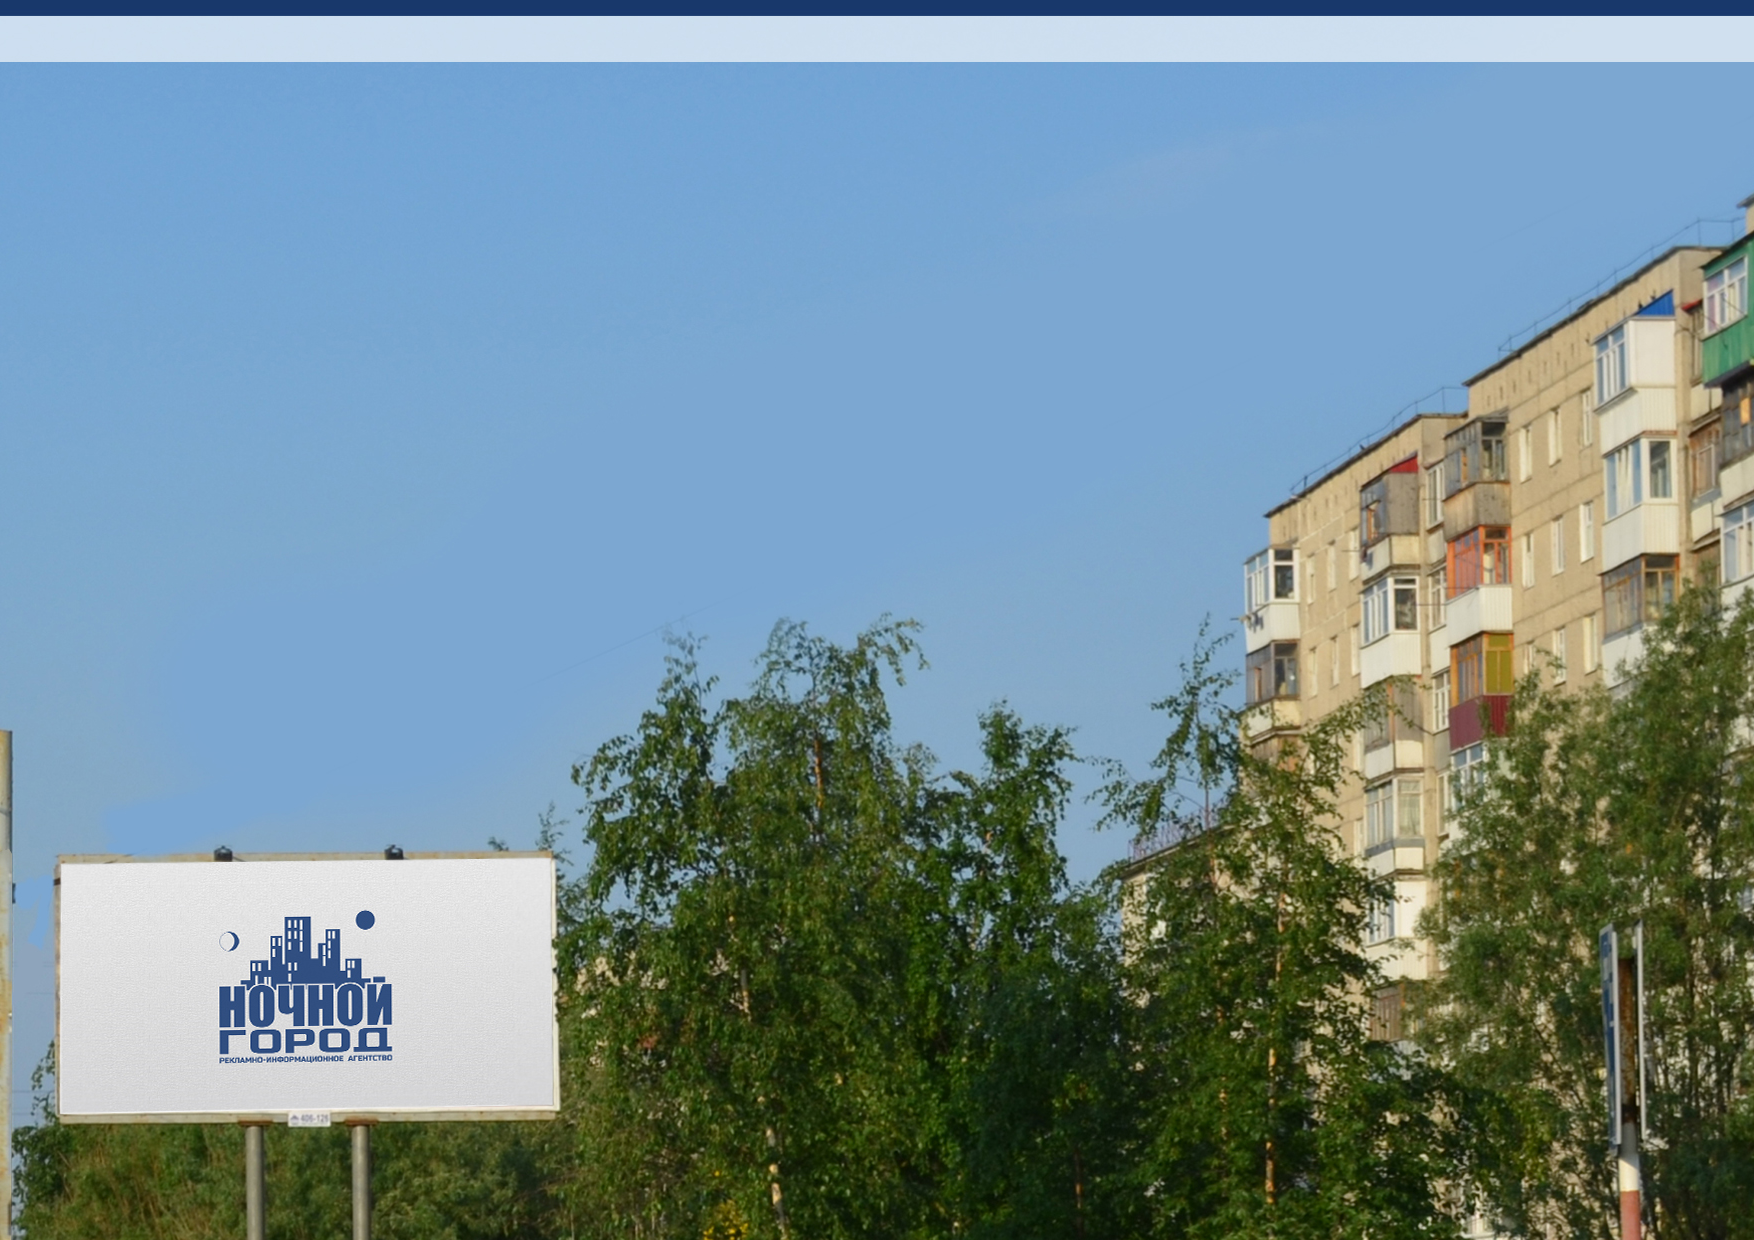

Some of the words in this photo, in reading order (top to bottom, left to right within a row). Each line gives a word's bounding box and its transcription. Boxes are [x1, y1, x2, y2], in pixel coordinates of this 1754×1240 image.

[219, 976, 393, 1028] НОЧНОЙ
[219, 1028, 393, 1055] ГОРОД
[219, 1055, 344, 1064] РЕКЛАМНО-ИНФОРМАЦИОННОЕ
[347, 1054, 393, 1062] АГЕНТСТВО
